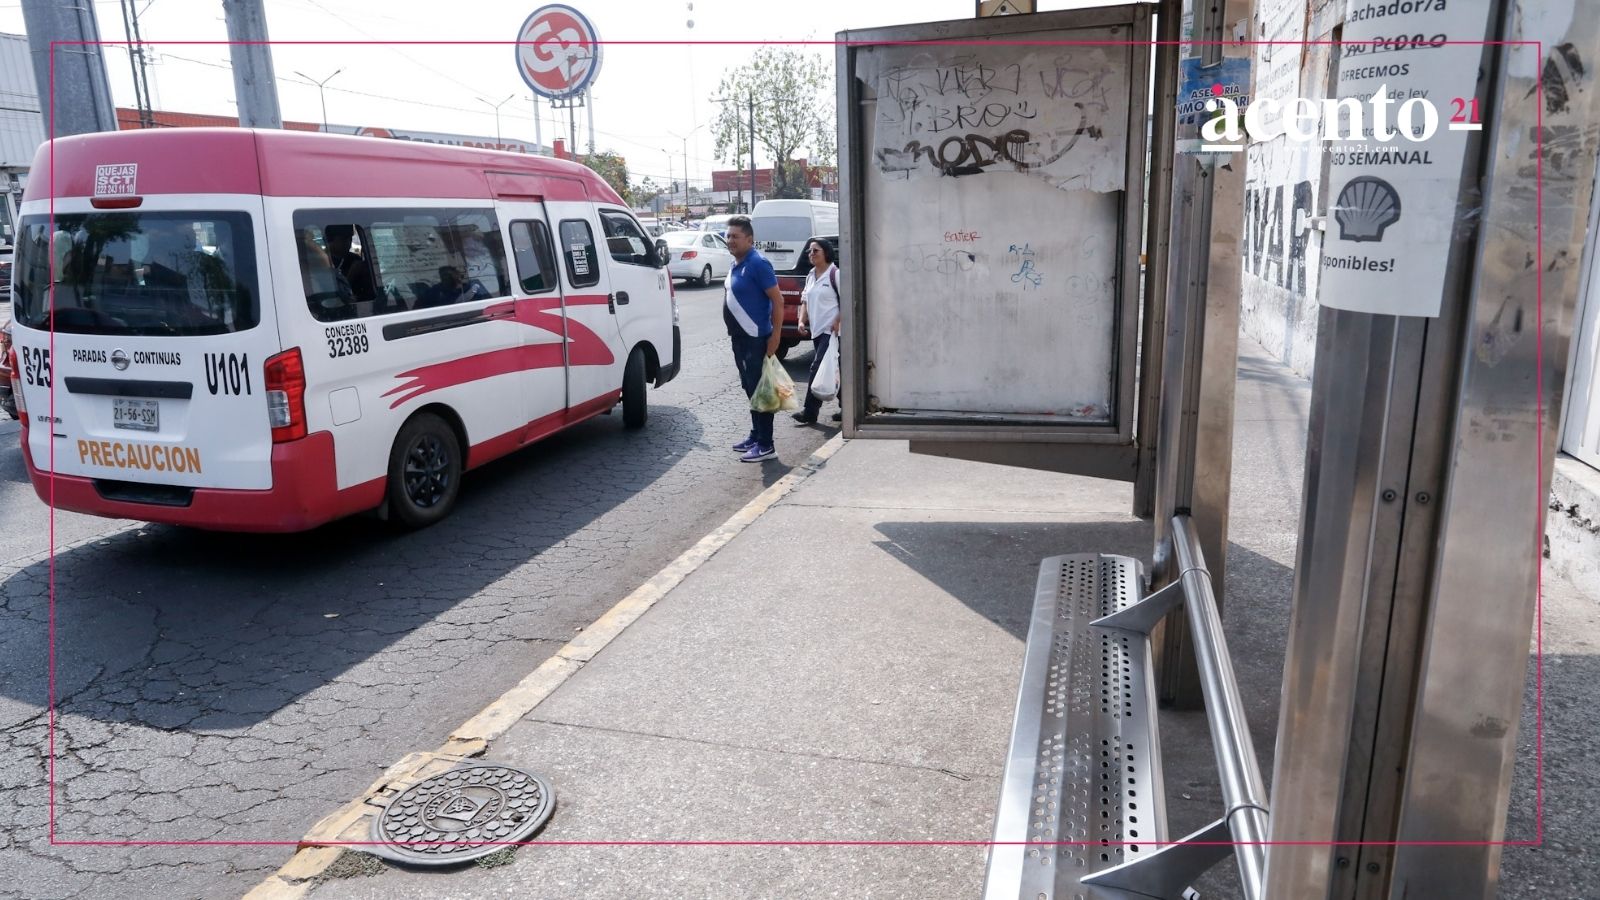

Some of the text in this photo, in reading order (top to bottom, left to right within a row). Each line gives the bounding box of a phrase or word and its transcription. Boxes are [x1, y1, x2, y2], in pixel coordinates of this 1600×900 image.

[1344, 0, 1446, 23] achador/a
[1340, 63, 1410, 82] OFRECEMOS
[1349, 150, 1433, 165] SEMANAL
[98, 166, 135, 177] QUEJAS
[98, 175, 134, 185] SCT
[325, 323, 367, 338] CONCESION
[327, 334, 369, 358] 32389
[73, 349, 182, 366] PARADAS CONTINUAS
[204, 352, 252, 396] U101
[77, 439, 203, 474] PRECAUCION
